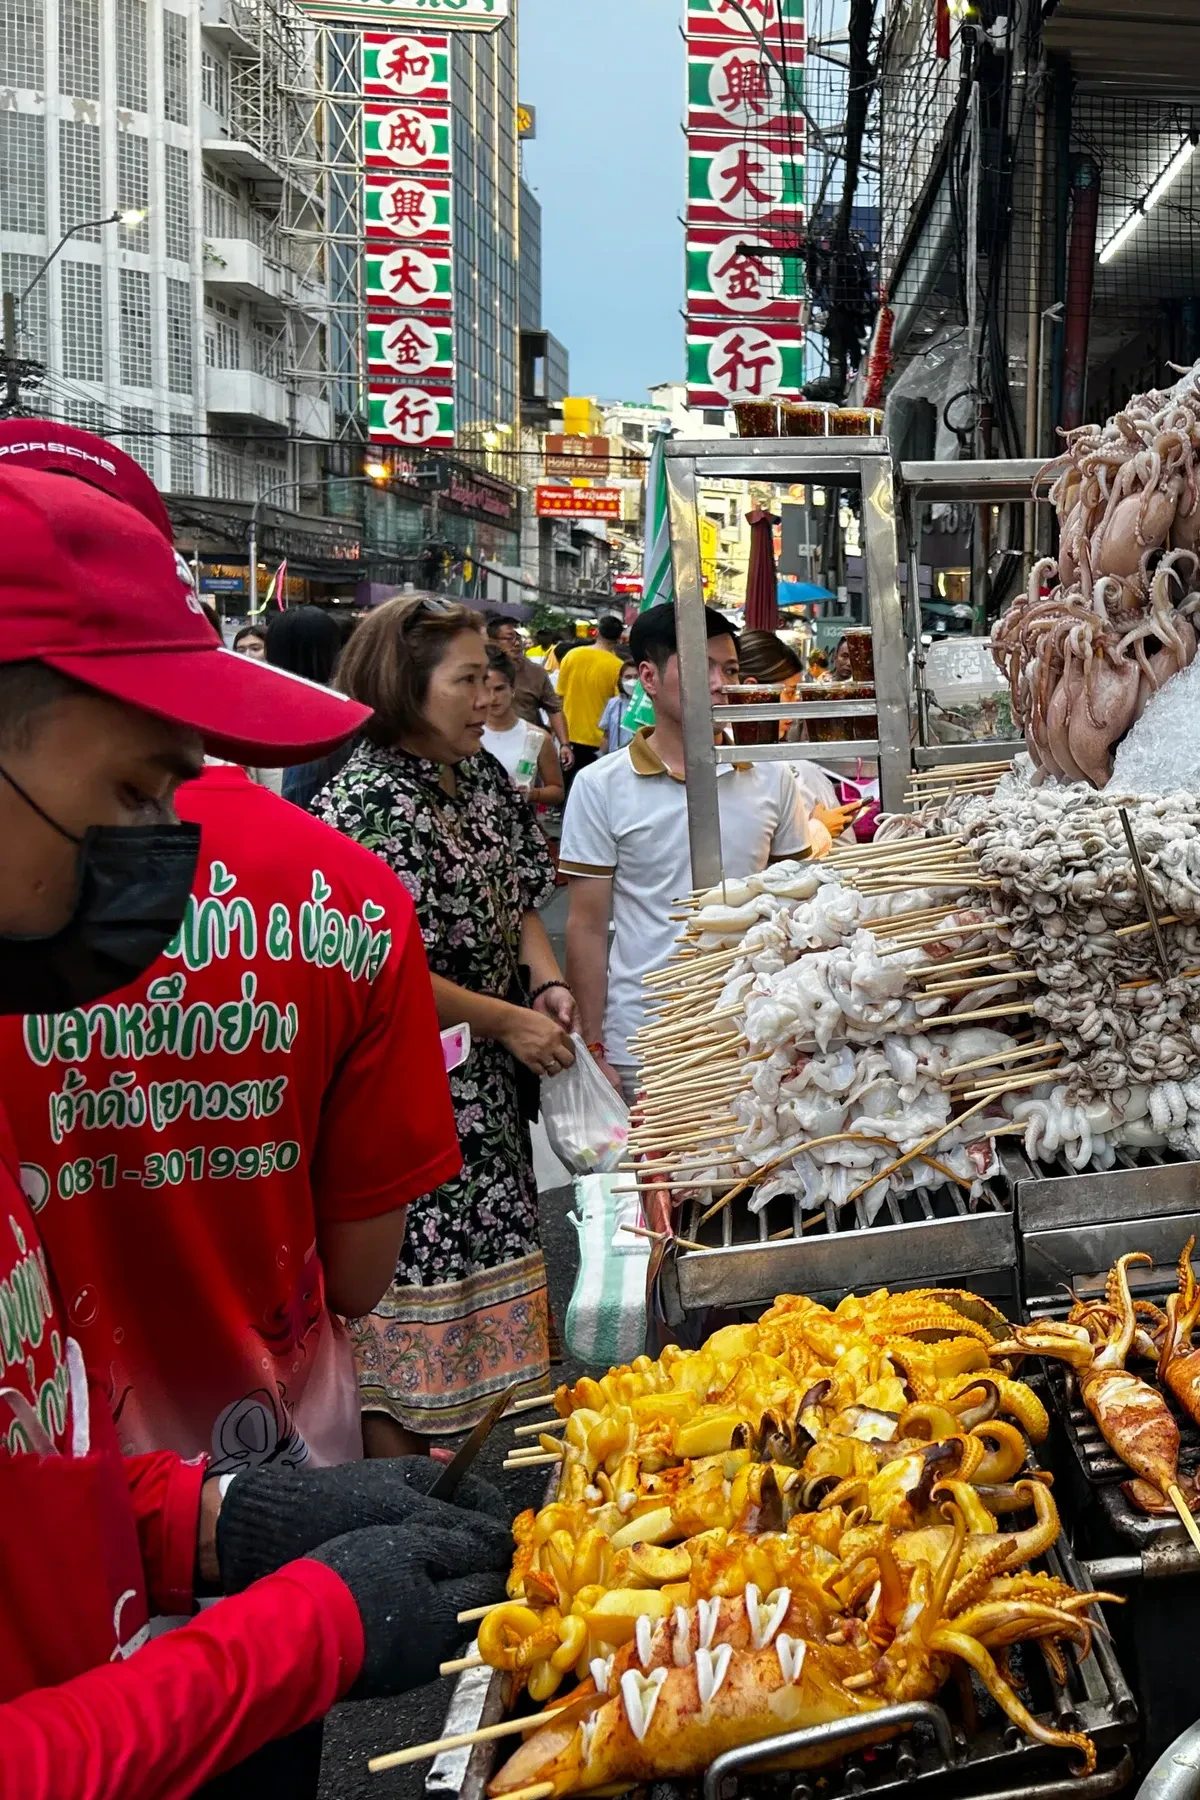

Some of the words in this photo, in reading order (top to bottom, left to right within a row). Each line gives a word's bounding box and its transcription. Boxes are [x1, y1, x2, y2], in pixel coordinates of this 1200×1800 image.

[385, 44, 433, 438] 和成興大金行
[266, 903, 293, 961] &
[23, 970, 298, 1067] ปลาหมึกย่าง
[57, 1140, 300, 1200] 081-3019950
